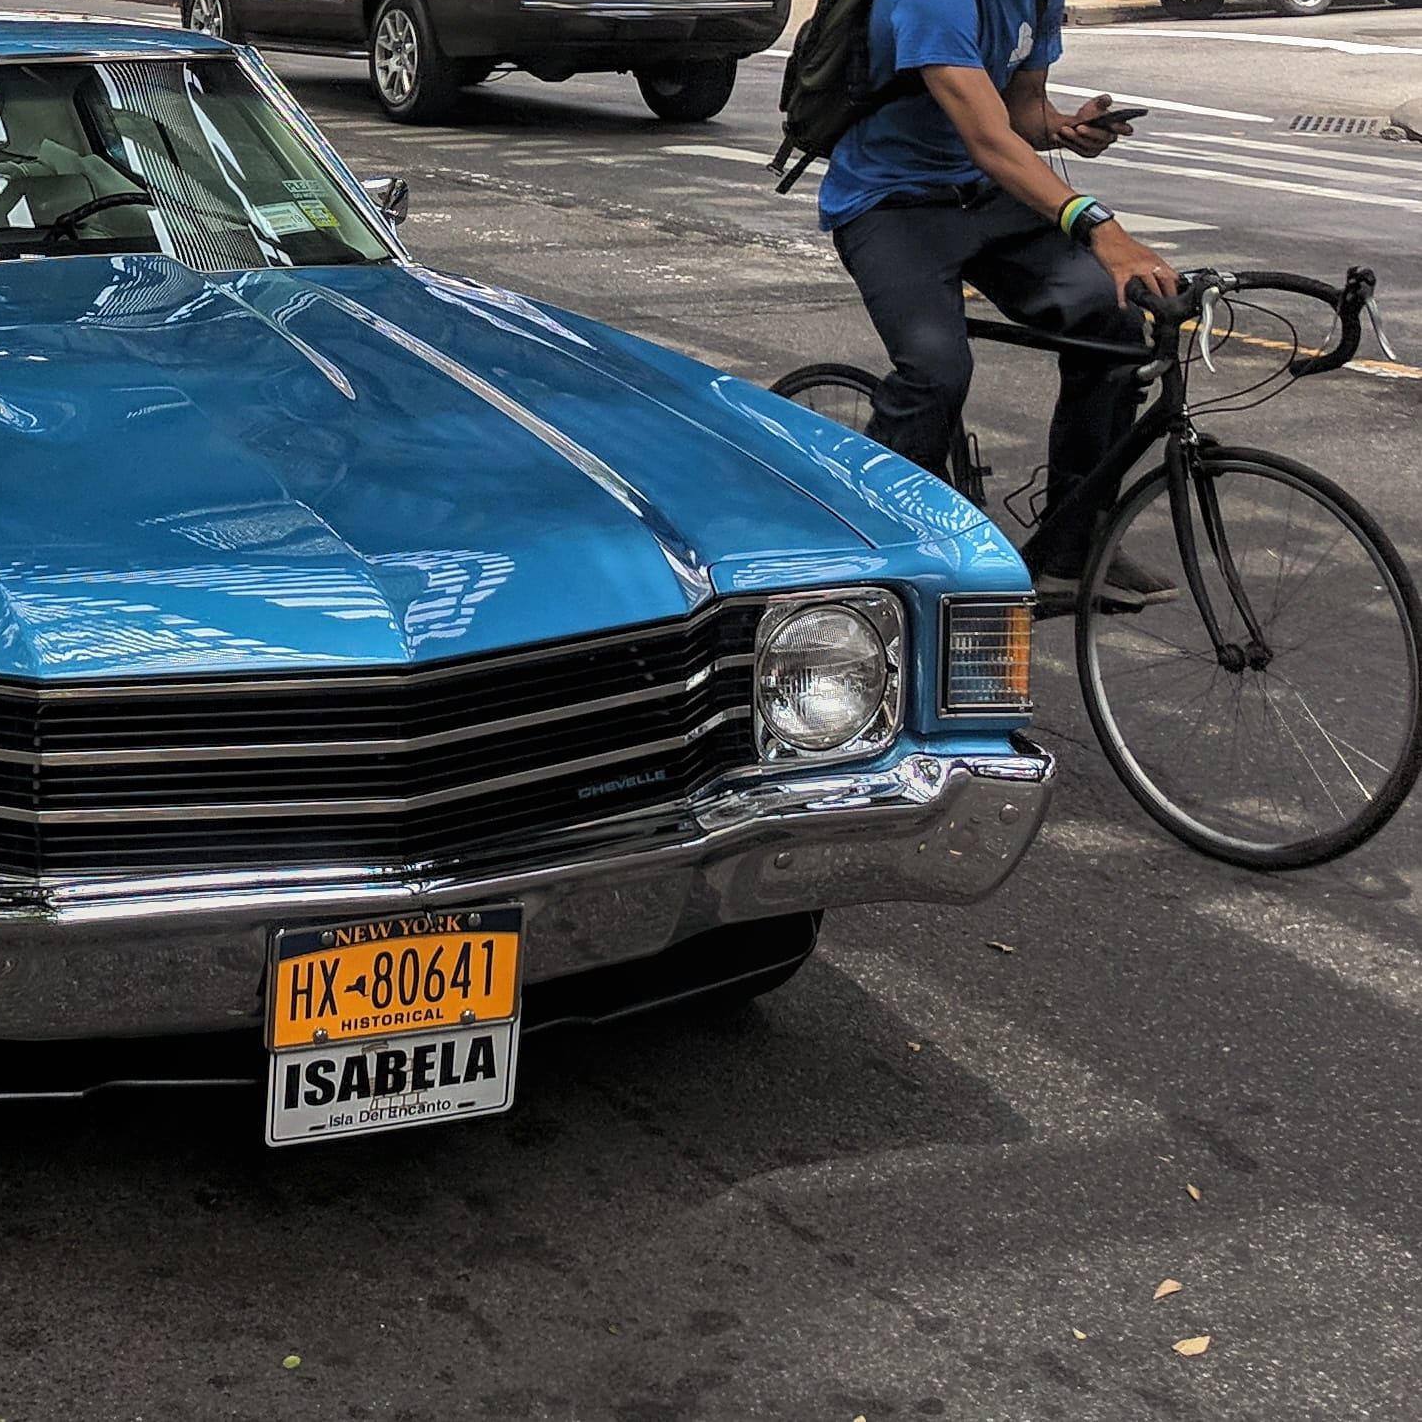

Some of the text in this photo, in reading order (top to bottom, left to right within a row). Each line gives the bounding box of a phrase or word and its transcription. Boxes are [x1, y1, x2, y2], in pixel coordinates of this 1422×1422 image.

[578, 769, 666, 799] CHEVELLE
[334, 914, 462, 947] NEW YORK
[341, 1008, 444, 1032] HISTORICAL
[283, 1035, 497, 1110] ISABELA
[329, 1099, 451, 1128] Isla Del Encanto
